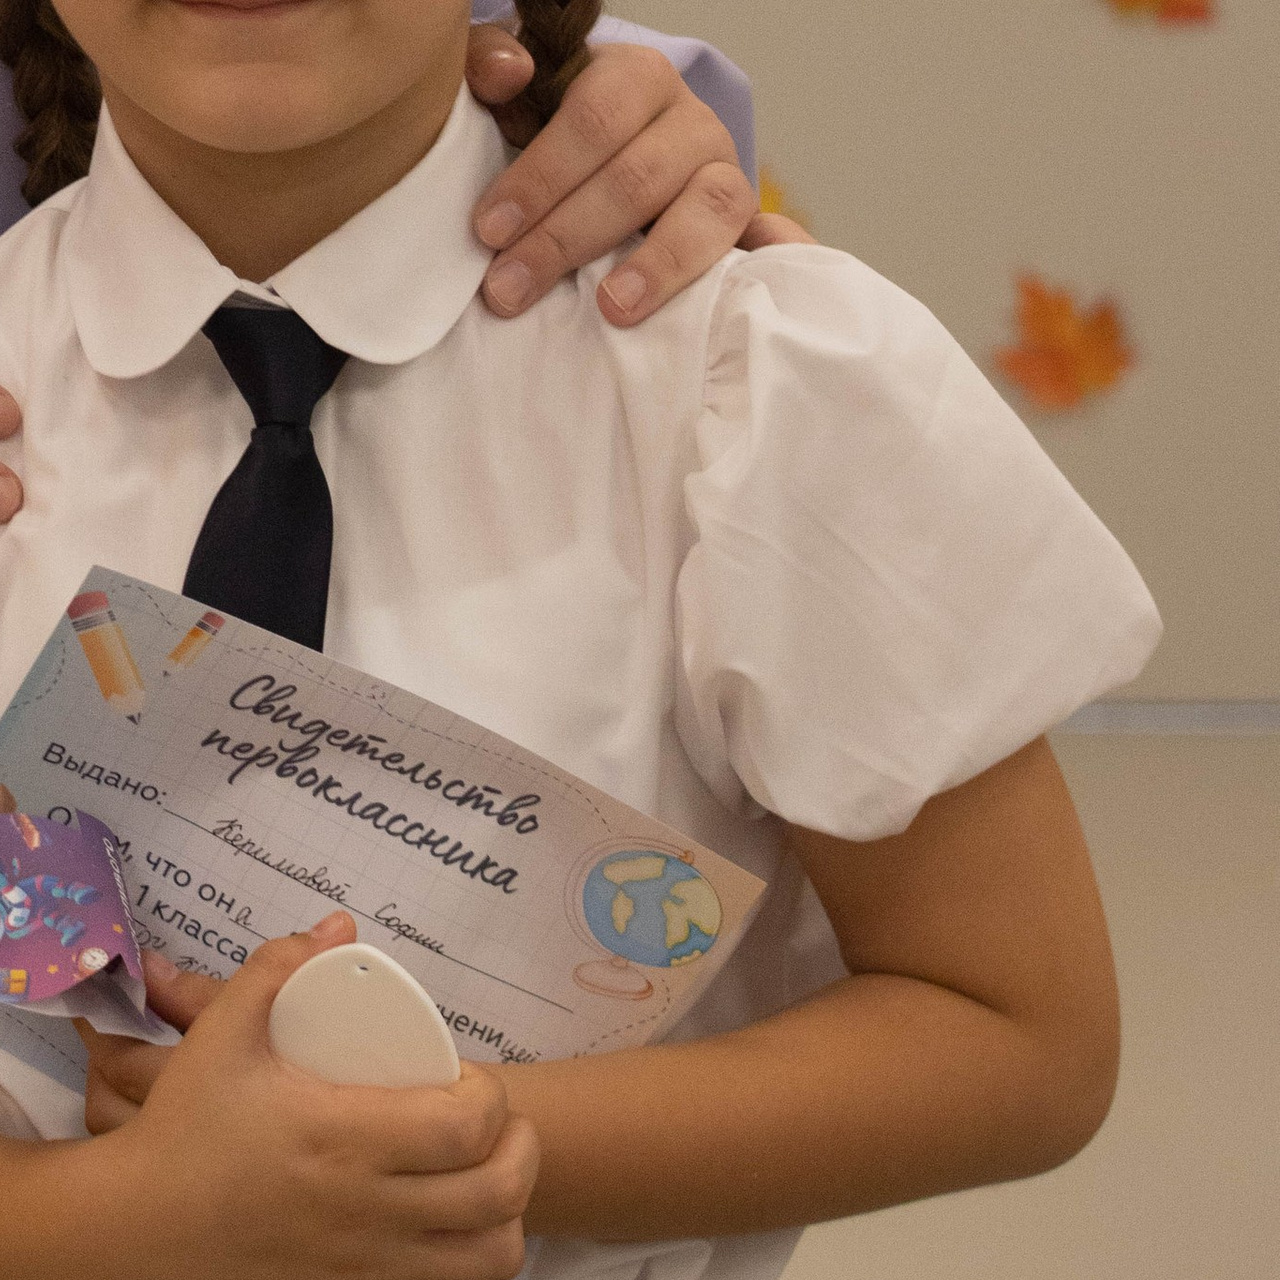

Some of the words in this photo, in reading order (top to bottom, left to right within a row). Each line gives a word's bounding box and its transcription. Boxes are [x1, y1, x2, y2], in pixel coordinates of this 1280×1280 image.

[41, 741, 169, 807] Выдано:
[200, 726, 521, 896] первоклассника
[229, 673, 541, 836] Свидетельство
[136, 883, 151, 908] 1
[150, 899, 250, 966] класса
[145, 851, 193, 889] что
[436, 1002, 542, 1066] ченицей
